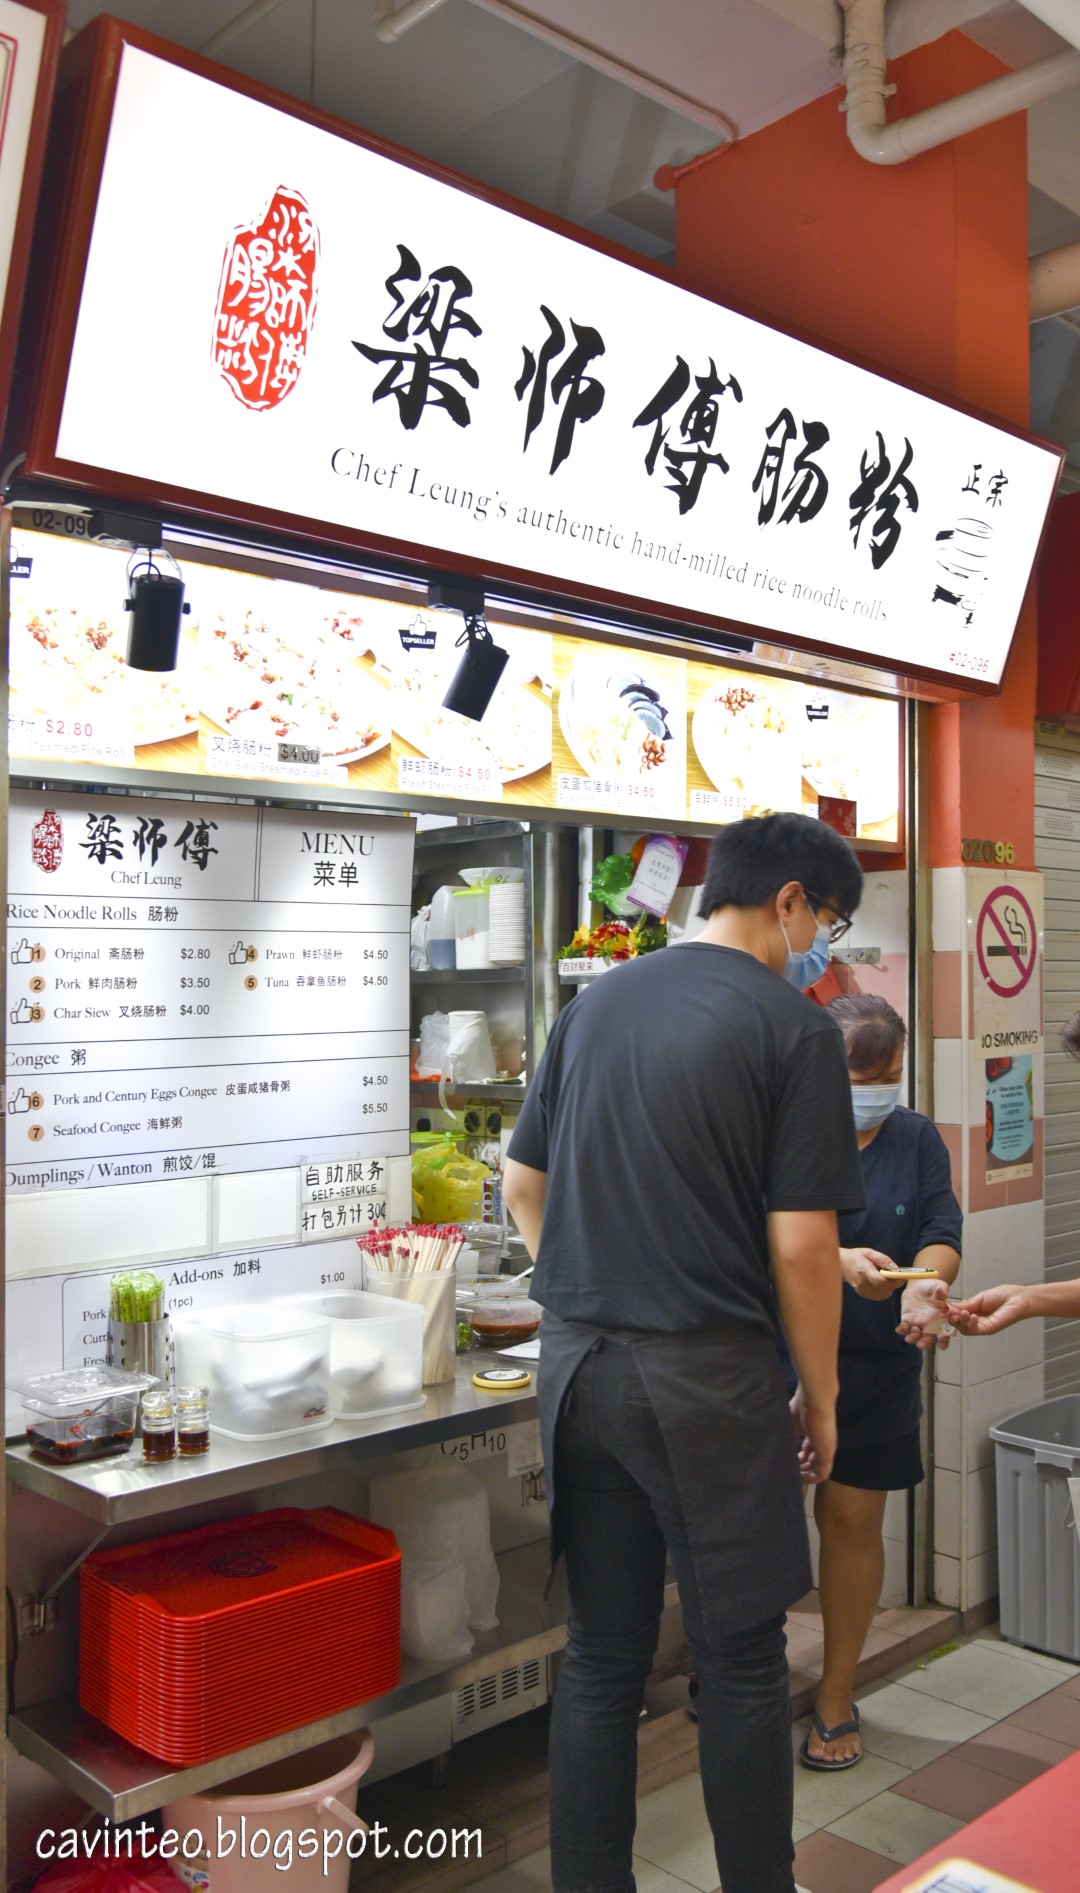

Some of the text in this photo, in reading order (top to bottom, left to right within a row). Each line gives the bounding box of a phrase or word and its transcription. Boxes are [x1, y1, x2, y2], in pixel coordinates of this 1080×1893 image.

[351, 244, 919, 570] 梁师傅肠粉
[961, 464, 1008, 507] 正宗
[331, 447, 887, 622] Chef Leung's authentic hand-milled rice noodle rolls
[401, 636, 435, 645] TOPSELLER
[45, 718, 93, 737] $2.80
[212, 736, 319, 763] 叉烧肠粉 $4.00
[78, 812, 219, 871] 梁师傅
[299, 831, 375, 856] MENU
[110, 870, 182, 890] Chef Leung
[313, 860, 359, 888] 菜单
[7, 903, 179, 922] Rice Noodle Rolls 肠粉
[34, 947, 211, 962] 1 Original 斋肠粉 $2.80
[248, 948, 389, 960] 4 Prawn 鲜虾肠粉 $4.50
[33, 977, 210, 990] 2 Pork 鲜肉肠粉 $3.50
[247, 975, 388, 988] 5 Tuna 吞拿鱼肠粉 $4.50
[34, 1004, 210, 1020] 3 Char Siew 叉烧肠粉 $4.00
[993, 1030, 1038, 1047] SMOKING
[6, 1049, 87, 1069] Congee 粥
[32, 1075, 388, 1107] 6 Pork and Century Eggs Congee 皮蛋咸猪骨粥 $4.50
[33, 1103, 388, 1139] 7 Seafood Congee 海鲜粥 $5.50
[305, 1160, 384, 1186] 自助服务
[311, 1183, 378, 1201] SELF-SERVICE
[302, 1205, 362, 1231] 打包另计
[168, 1258, 262, 1287] Add-ons 加料
[82, 1271, 345, 1322] Pork (1pc) $1.00
